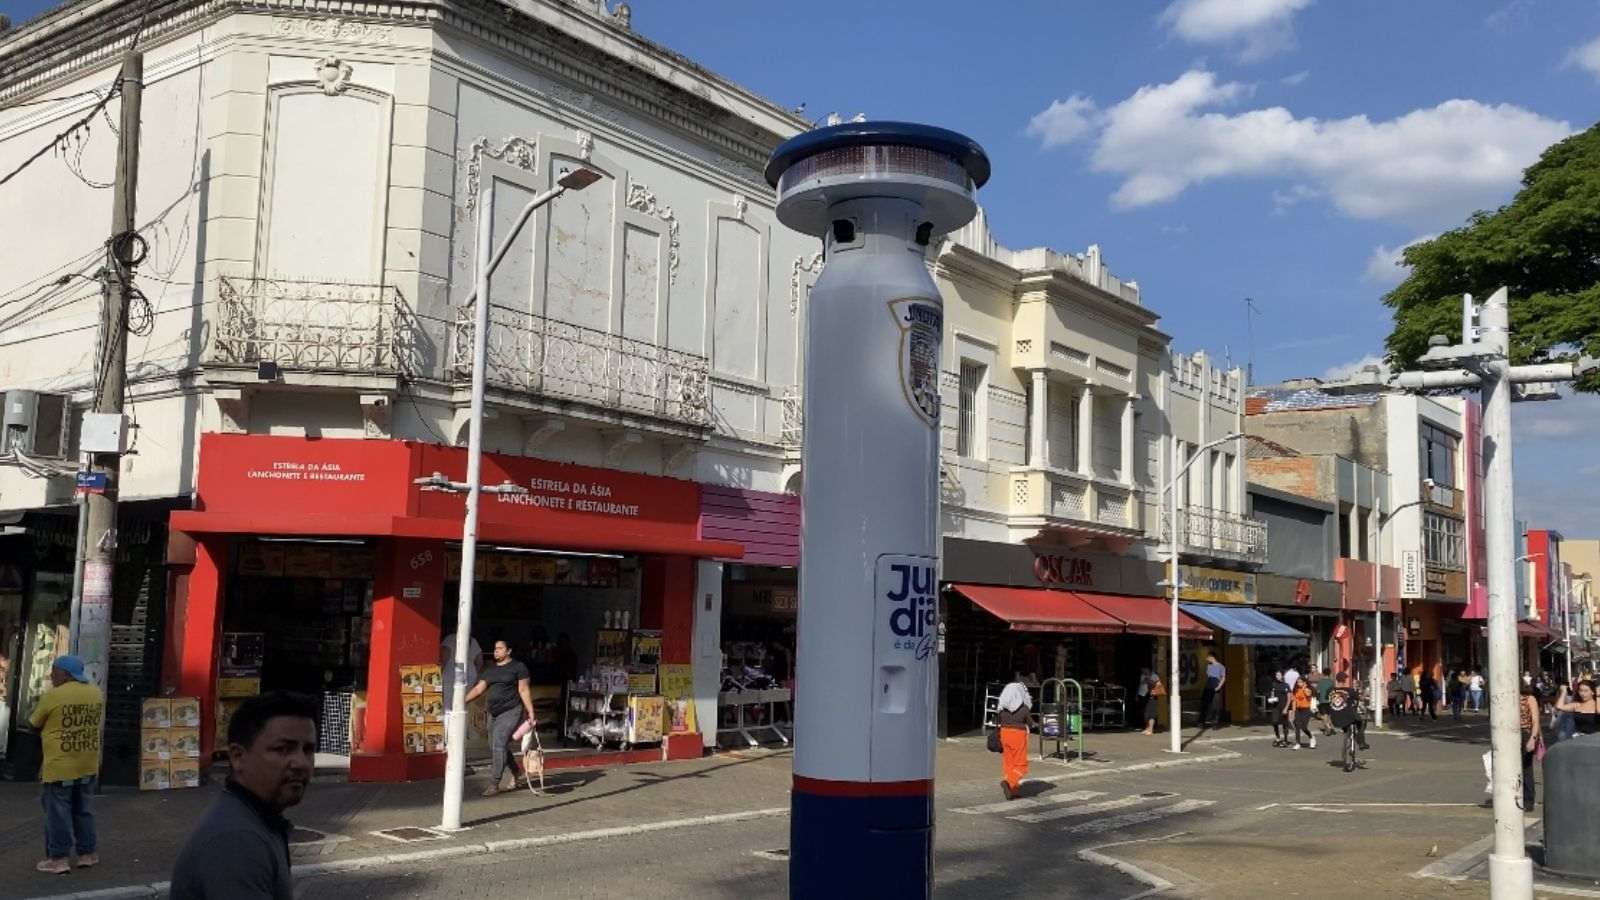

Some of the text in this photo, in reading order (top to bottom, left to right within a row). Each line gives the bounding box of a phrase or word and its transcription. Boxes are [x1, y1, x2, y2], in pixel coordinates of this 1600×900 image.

[247, 471, 301, 479] LANCHONETE
[310, 472, 365, 480] RESTAURANTE
[273, 462, 341, 471] ESTRELA DA ÁSIA
[531, 478, 612, 496] ESTRELA DA ÁSIA
[498, 493, 566, 508] LANCHONETE
[575, 500, 639, 515] RESTAURANTE
[410, 550, 432, 569] 658
[1033, 555, 1092, 585] OSCAR
